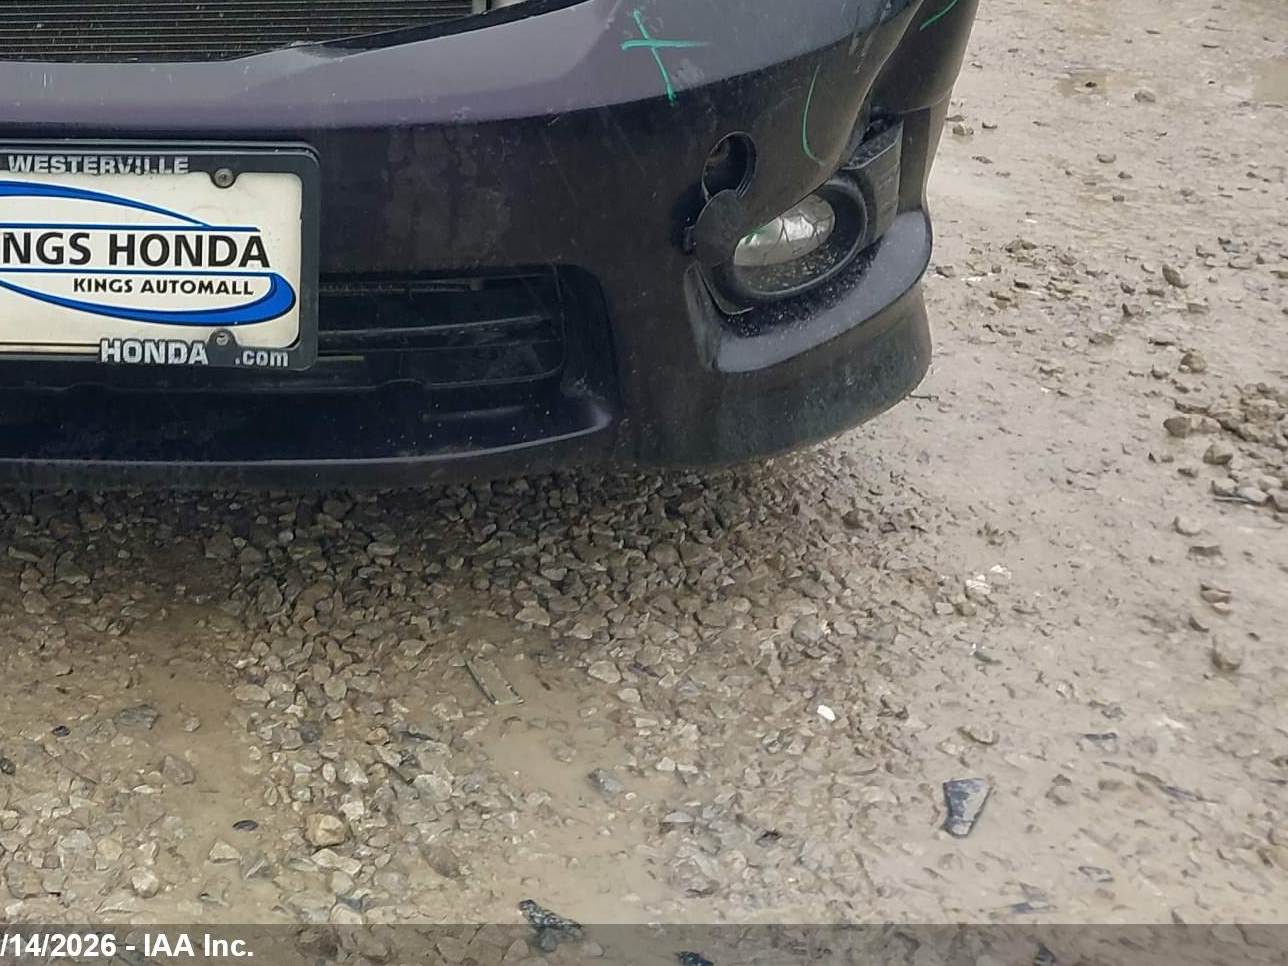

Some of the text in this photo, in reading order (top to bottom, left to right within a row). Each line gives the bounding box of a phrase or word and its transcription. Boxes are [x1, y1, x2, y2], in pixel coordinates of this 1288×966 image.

[7, 154, 190, 174] WESTERVILLE
[107, 233, 272, 268] HONDA
[72, 277, 254, 296] KINGS AUTOMALL
[100, 338, 209, 365] HONDA
